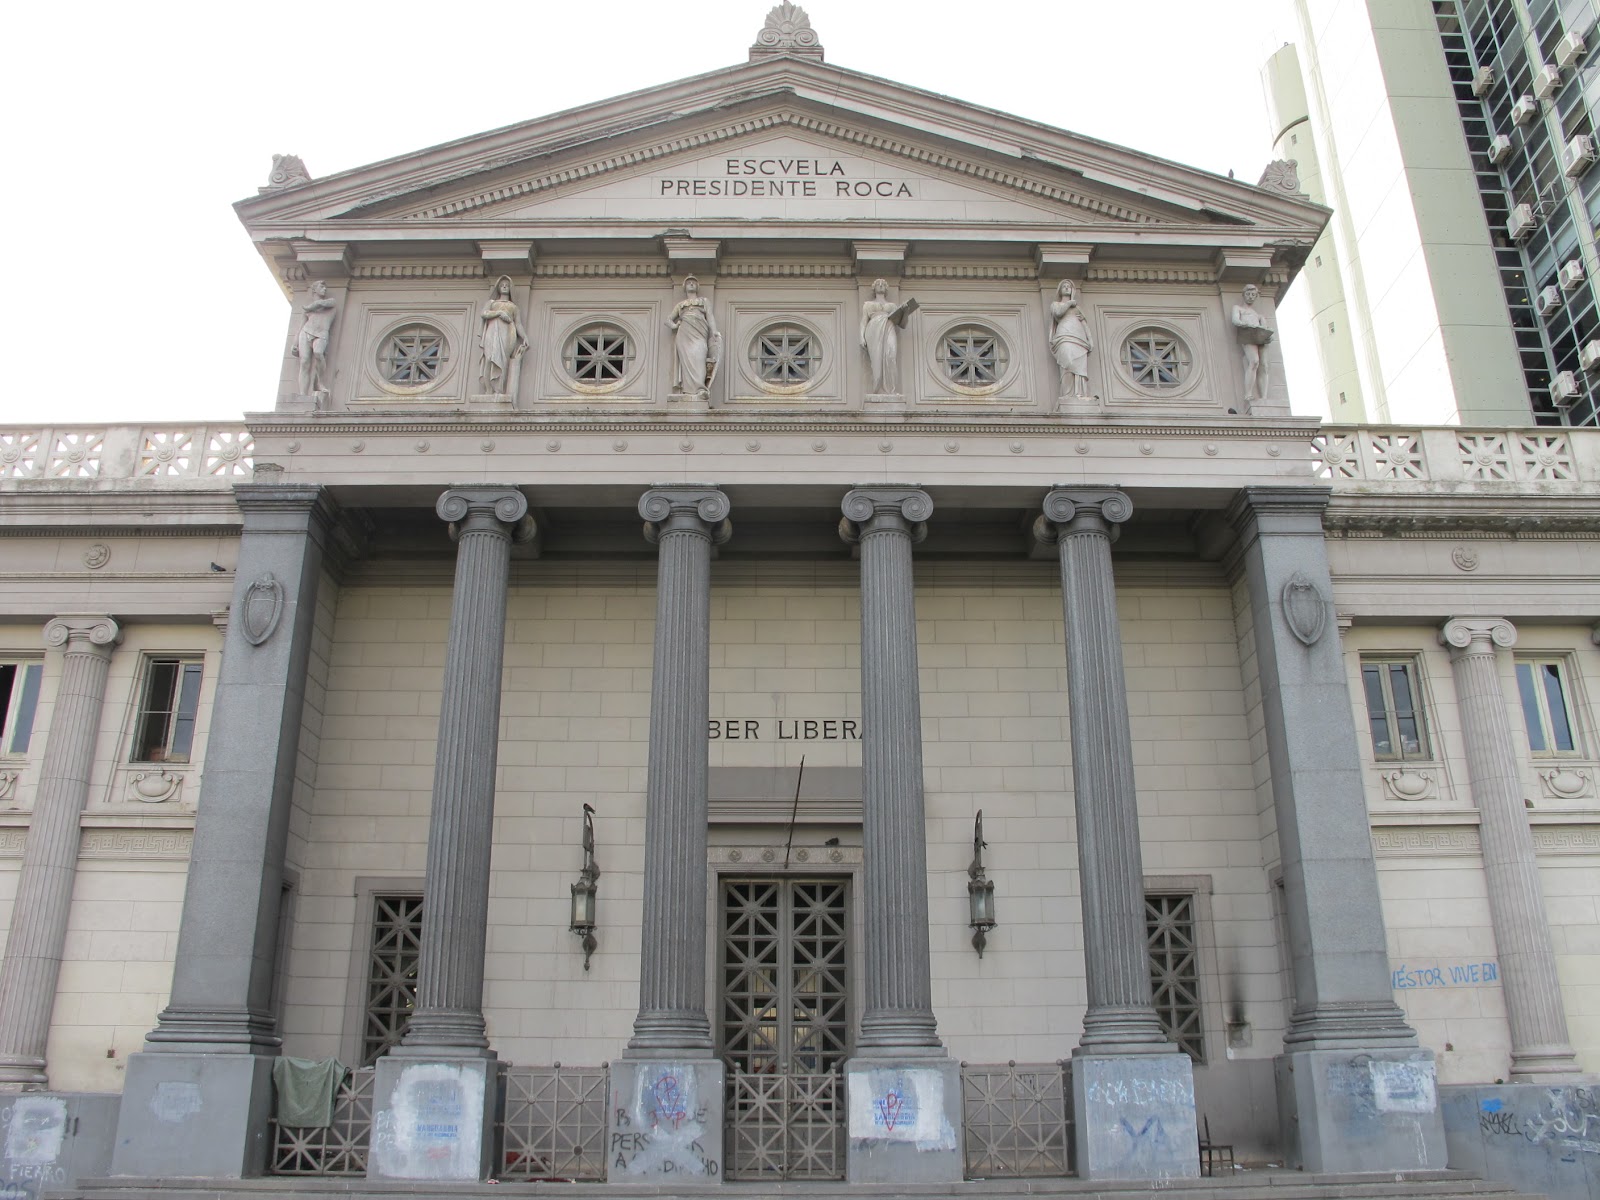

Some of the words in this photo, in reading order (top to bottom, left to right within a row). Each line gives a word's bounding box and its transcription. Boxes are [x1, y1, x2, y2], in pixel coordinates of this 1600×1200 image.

[726, 159, 846, 176] ESCVELA
[660, 179, 817, 197] PRESIDENTE
[835, 180, 914, 198] ROCA
[778, 720, 862, 740] LIBER
[1448, 964, 1480, 984] VIVE
